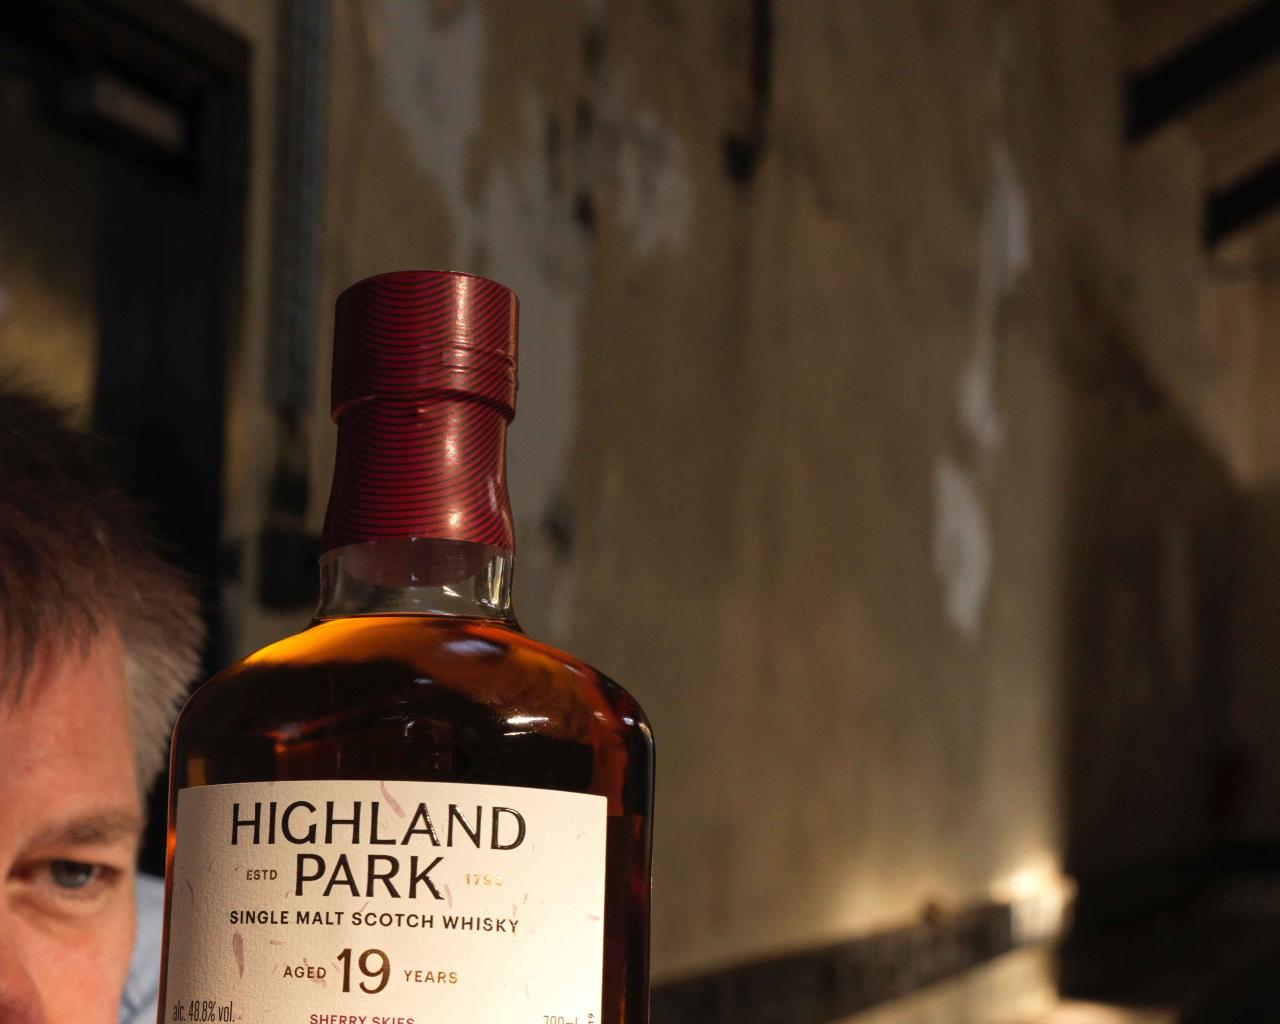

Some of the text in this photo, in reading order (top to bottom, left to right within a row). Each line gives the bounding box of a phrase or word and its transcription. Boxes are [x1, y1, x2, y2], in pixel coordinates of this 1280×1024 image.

[231, 800, 526, 851] HIGHLAND
[246, 869, 278, 881] ESTD
[295, 853, 445, 900] PARK
[229, 910, 519, 933] SINGLE MALT SCOTCH WHISKY
[283, 948, 458, 994] AGED 19 YEARS
[173, 1000, 235, 1023] alc. 48.8% vol.
